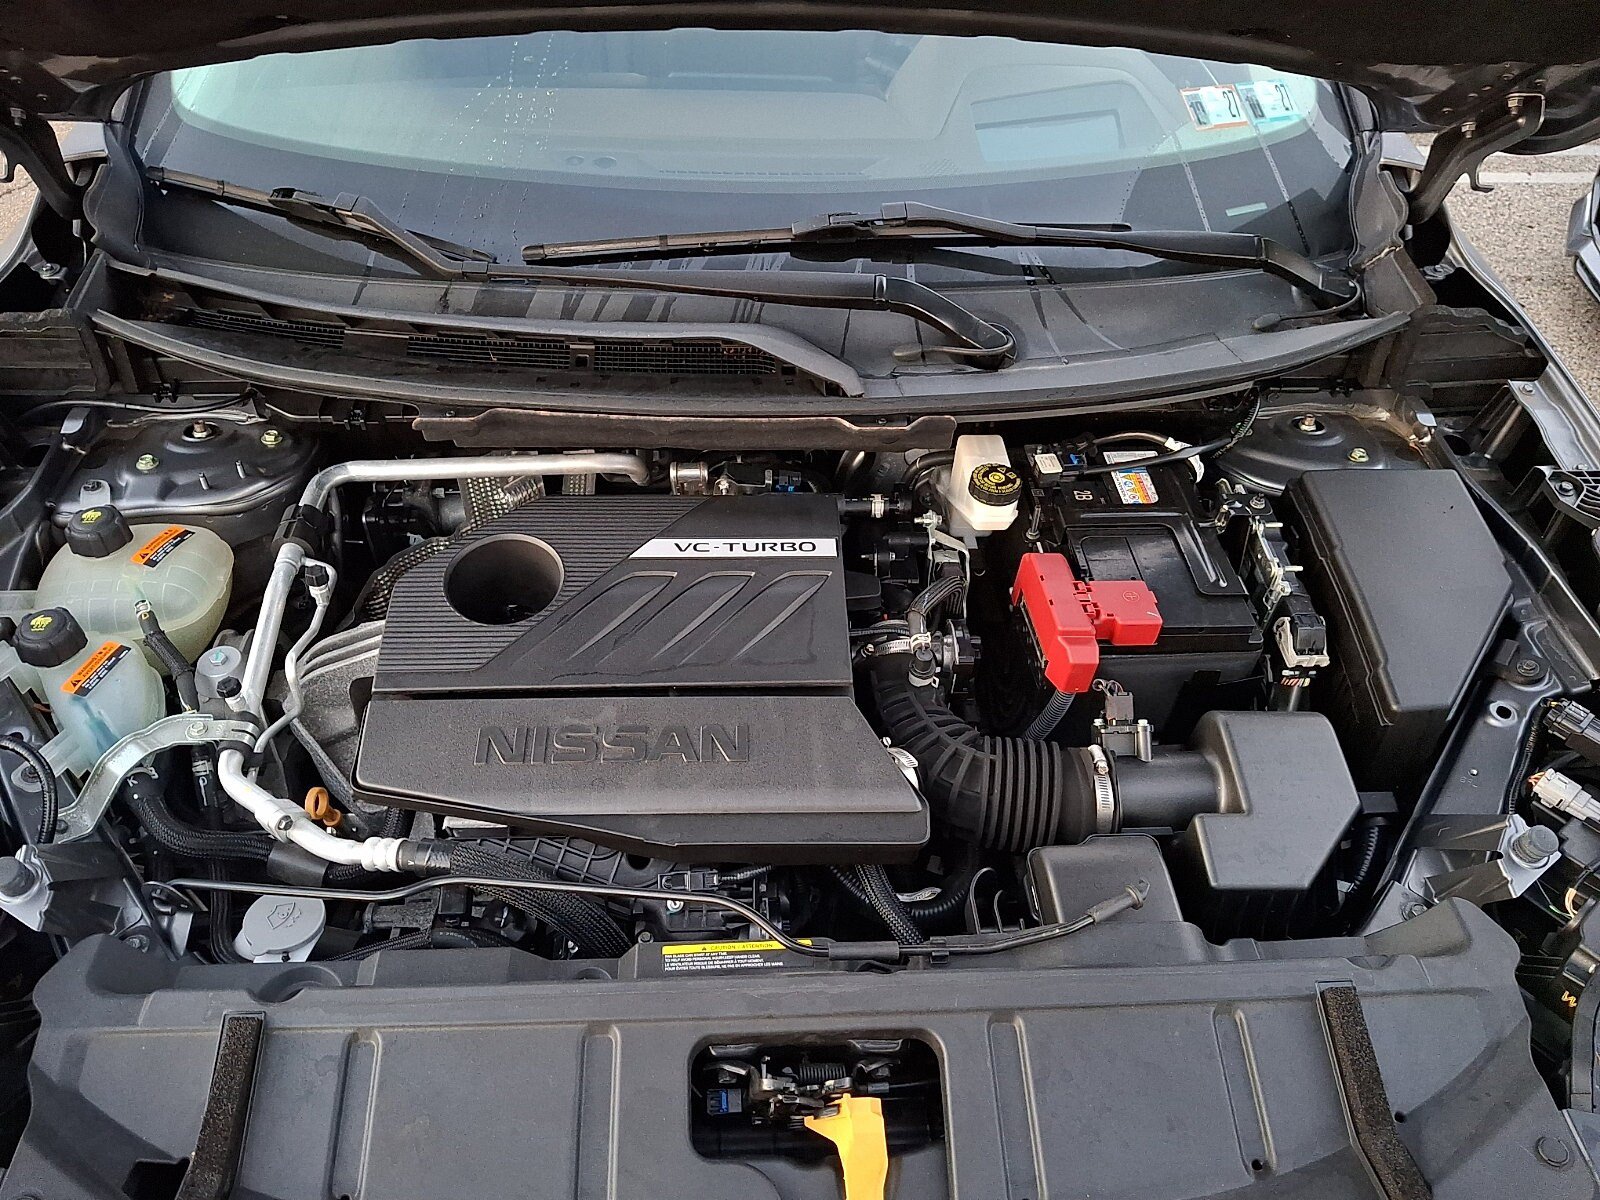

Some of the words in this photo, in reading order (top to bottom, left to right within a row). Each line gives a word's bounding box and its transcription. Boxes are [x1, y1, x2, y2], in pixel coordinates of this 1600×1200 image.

[1222, 90, 1241, 118] 27
[1274, 84, 1294, 111] 27
[674, 542, 817, 553] VC-TURBO
[474, 723, 750, 765] NISSAN
